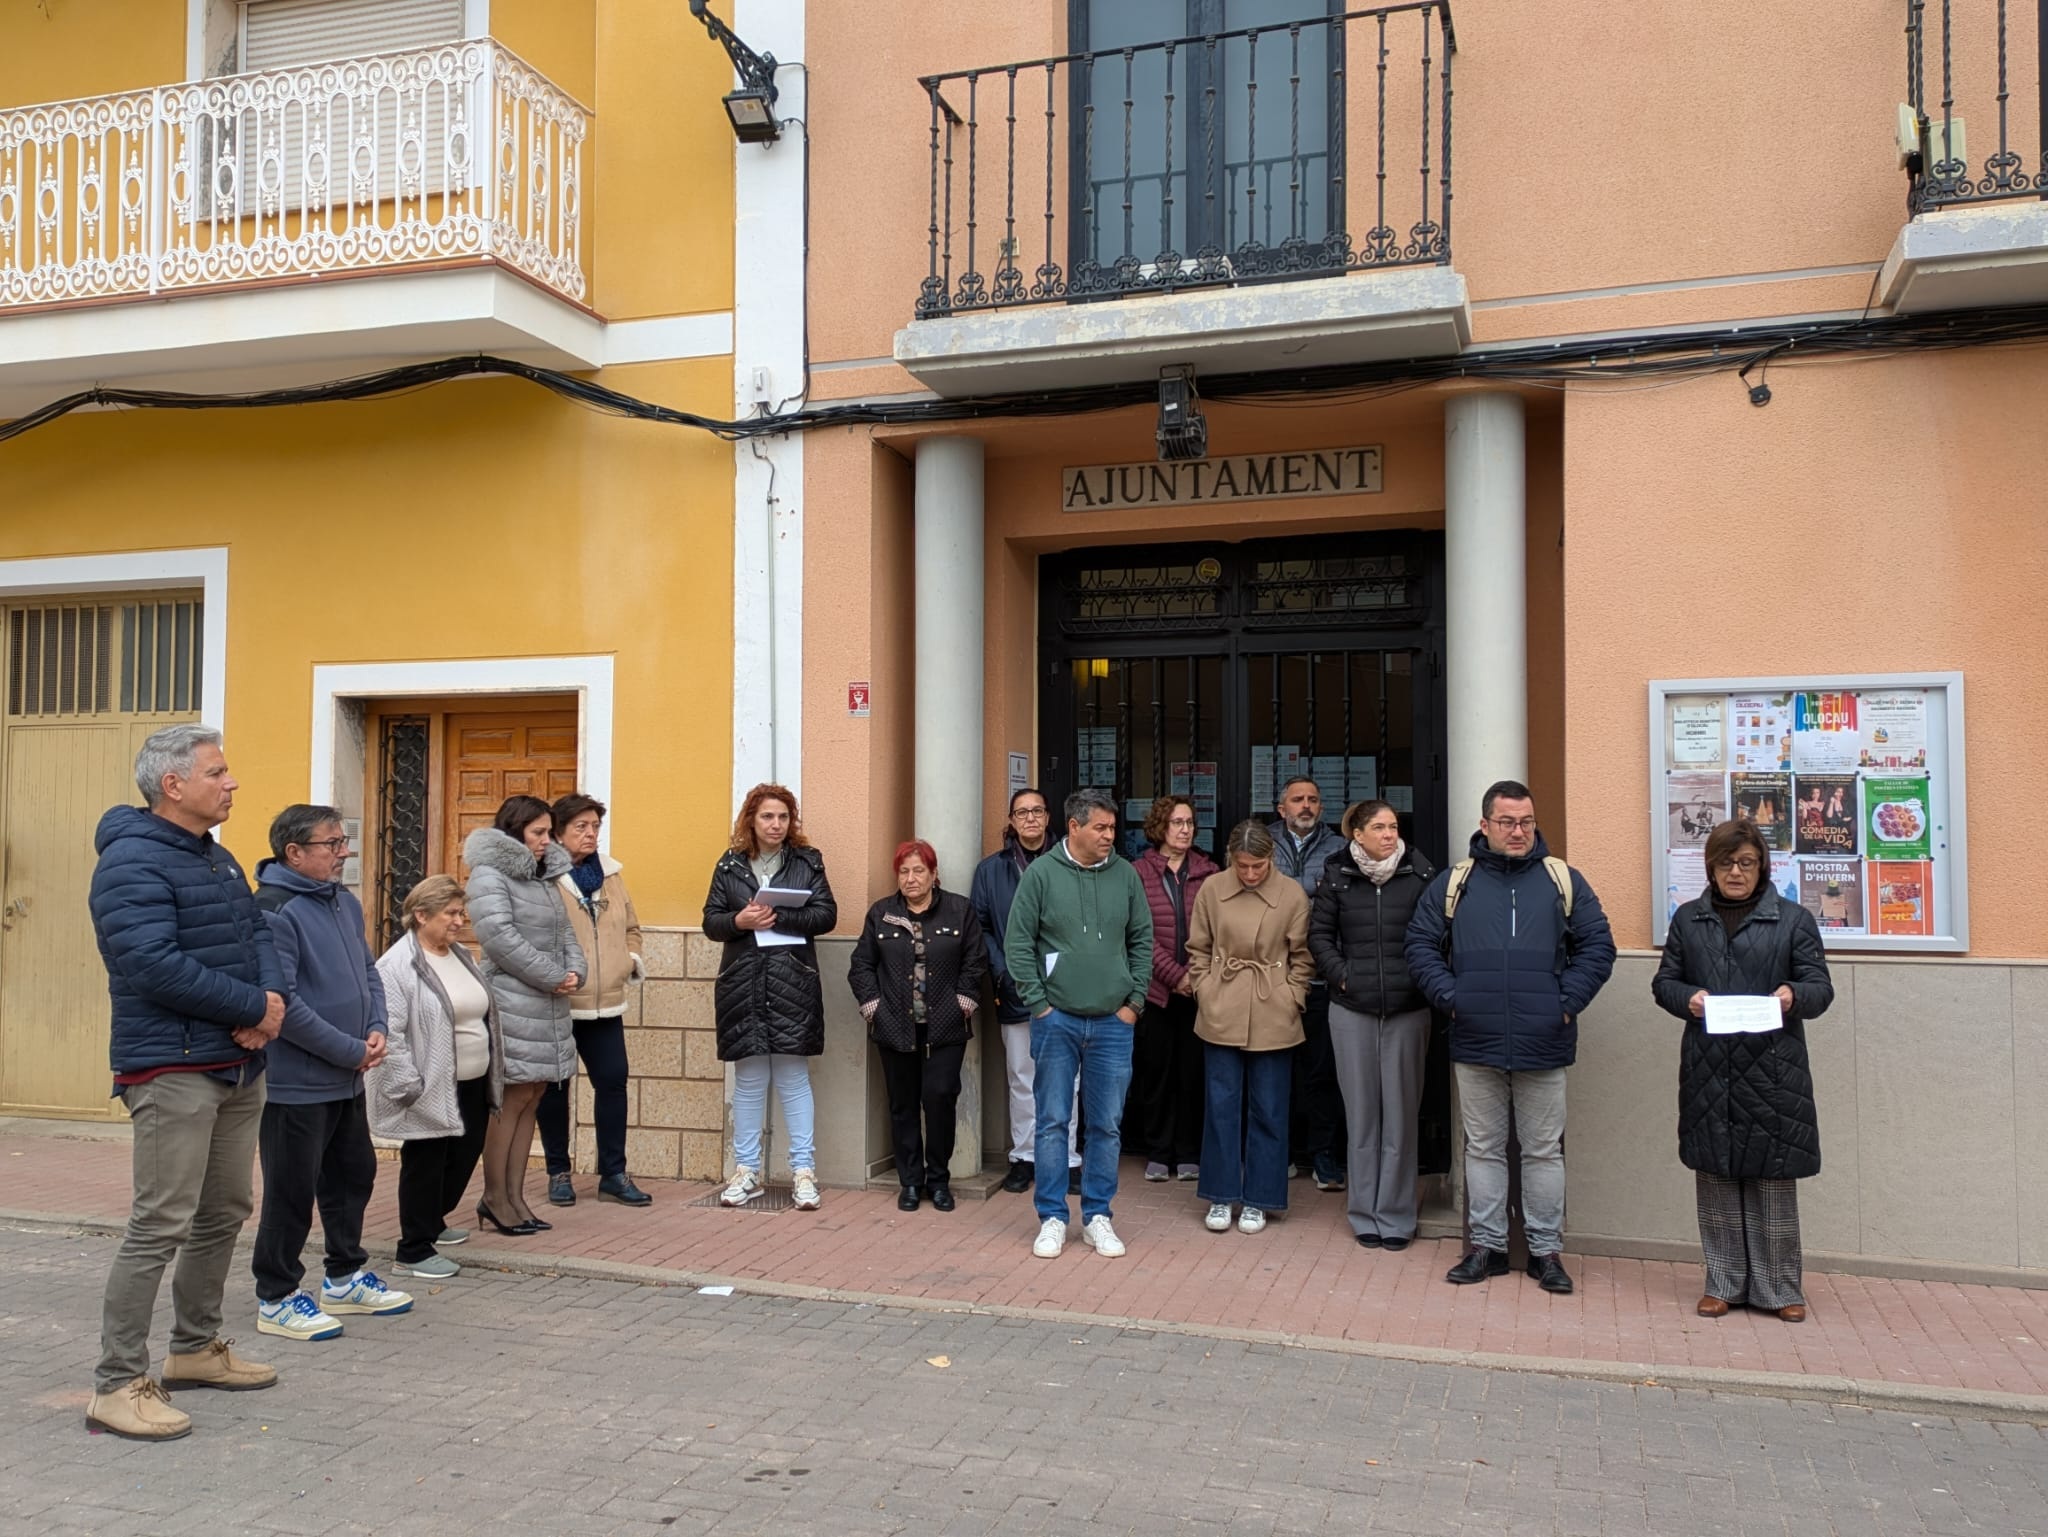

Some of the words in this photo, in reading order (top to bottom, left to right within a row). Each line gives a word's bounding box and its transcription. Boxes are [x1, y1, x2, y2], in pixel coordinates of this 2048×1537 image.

[1065, 450, 1378, 507] AJUNTAMENT
[1802, 712, 1849, 725] OLOCAU
[1800, 826, 1849, 834] COMEDIA
[1823, 834, 1853, 849] VIDA
[1805, 863, 1850, 872] MOSTRA
[1805, 873, 1856, 882] D'HIVERN
